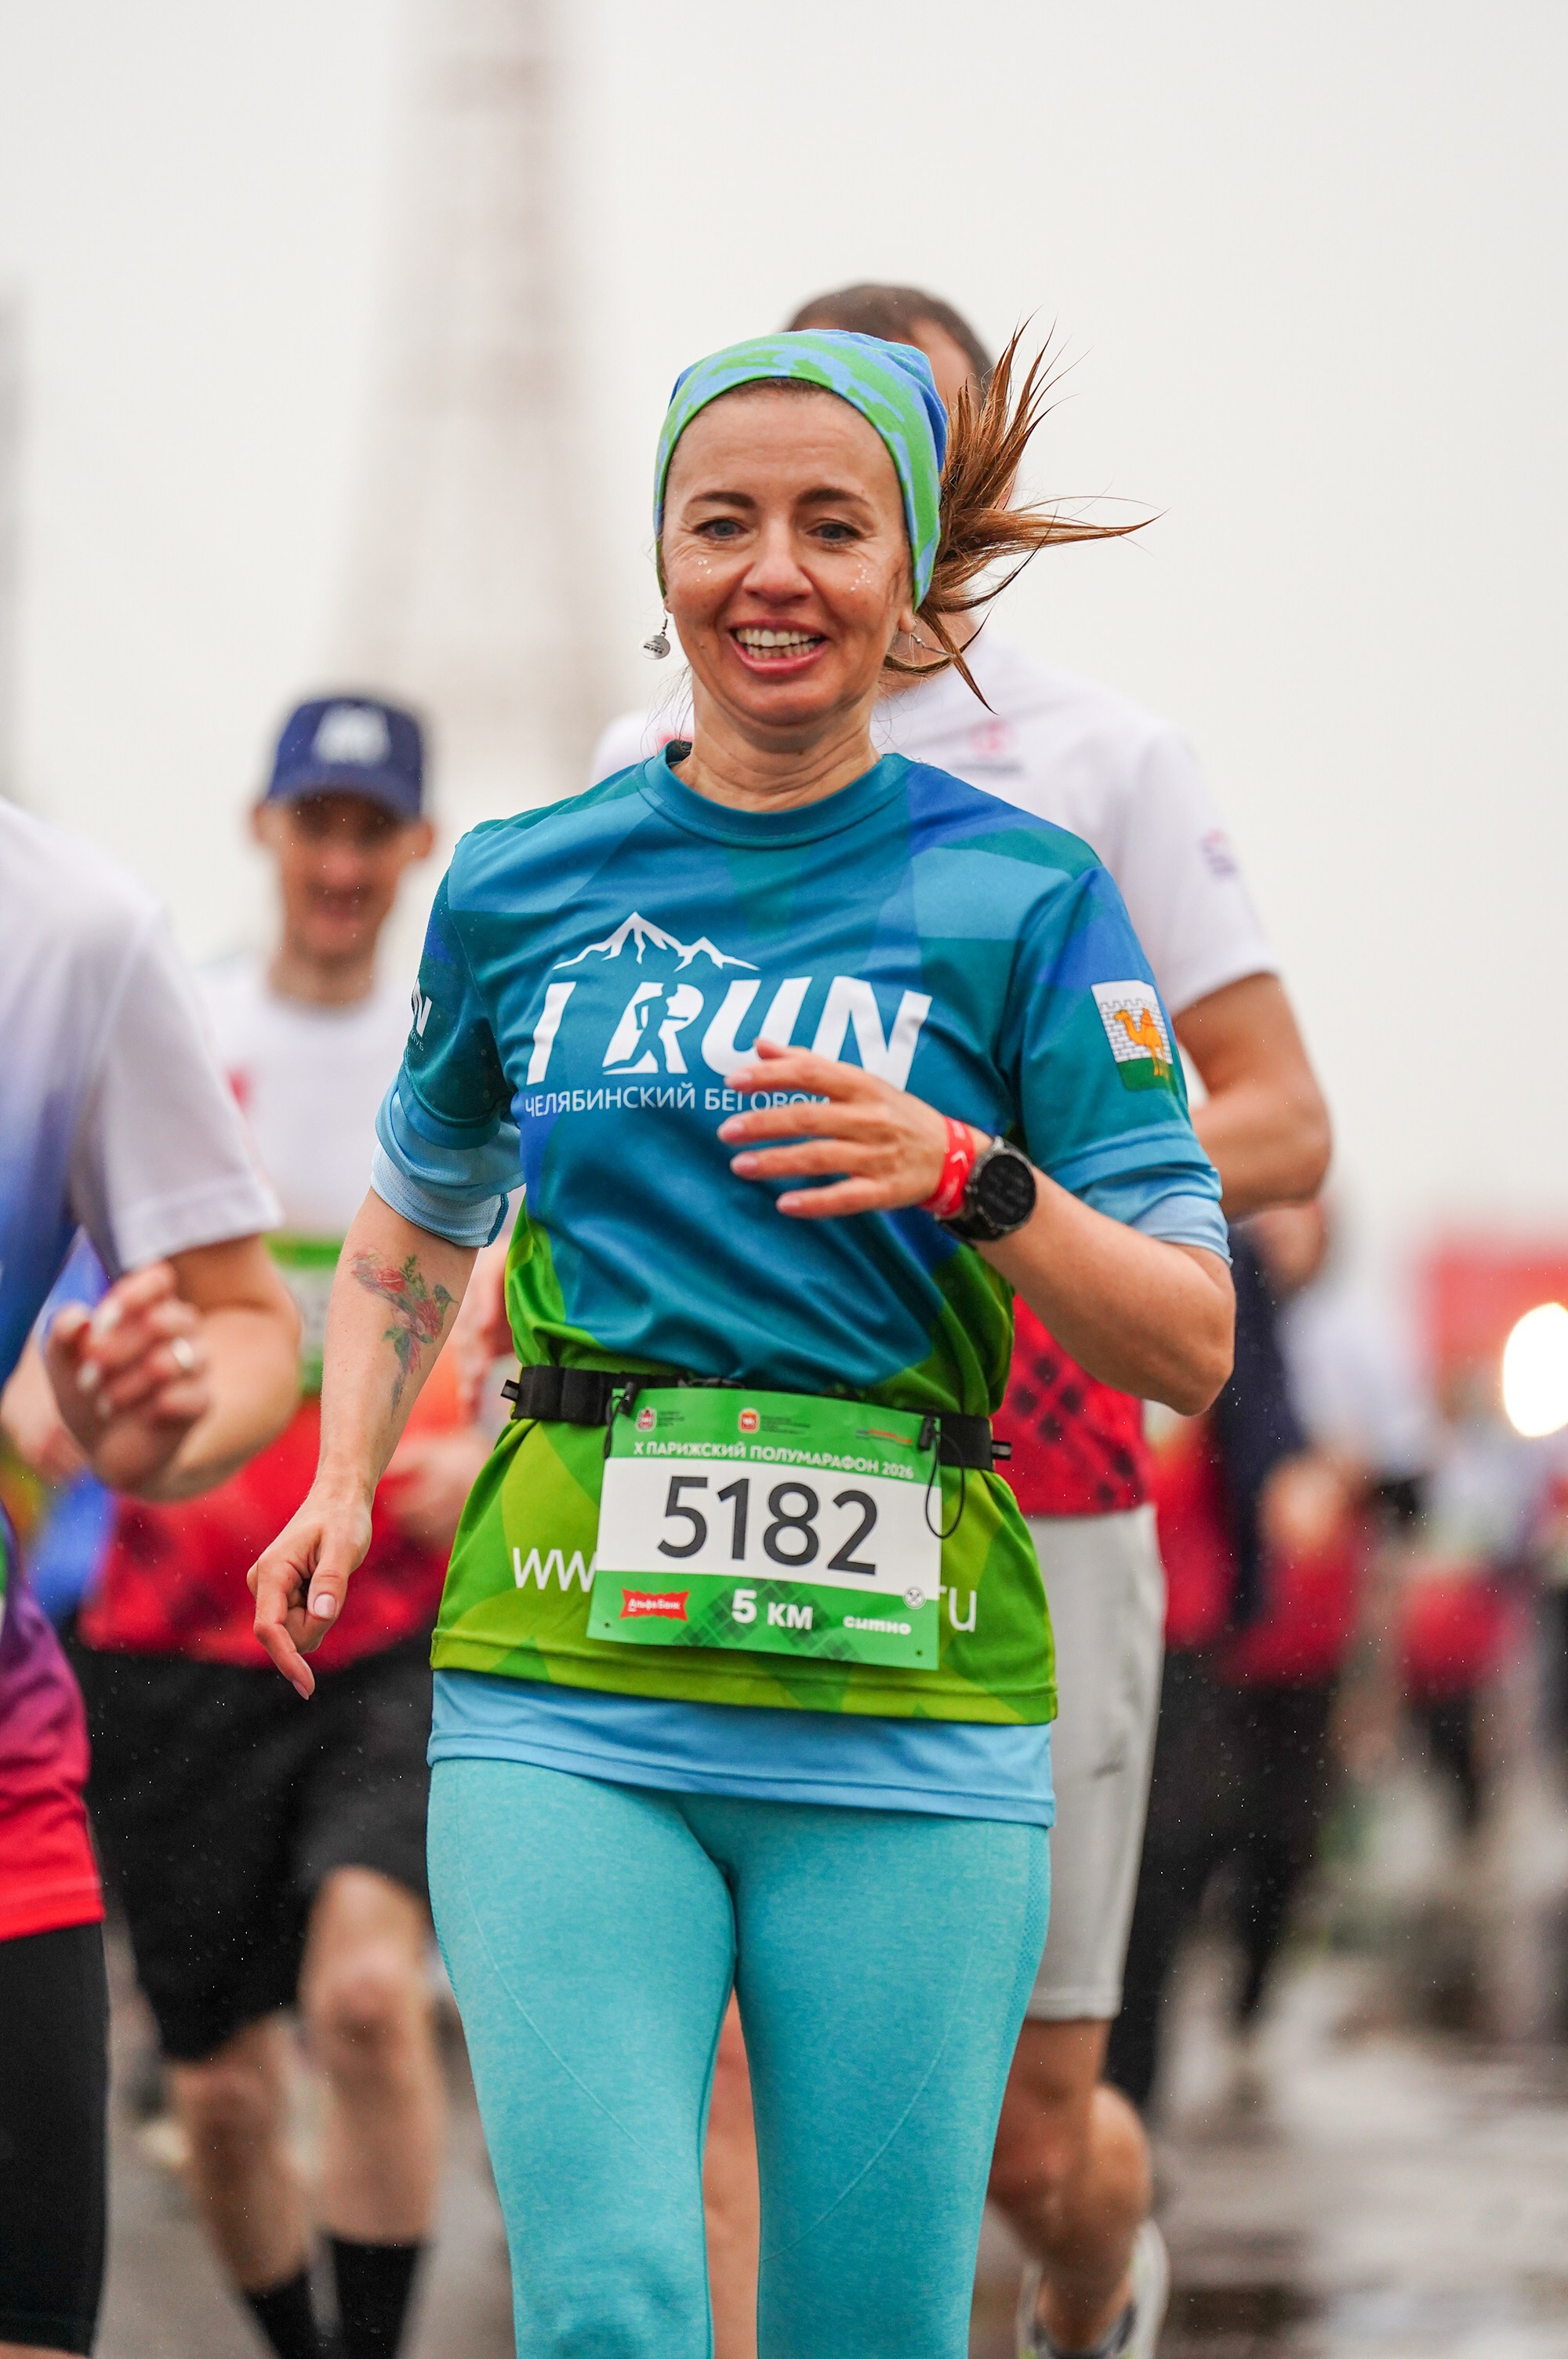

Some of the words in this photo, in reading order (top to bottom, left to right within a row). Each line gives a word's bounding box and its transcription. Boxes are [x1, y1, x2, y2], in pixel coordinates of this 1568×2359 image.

[526, 981, 577, 1086] I
[602, 976, 934, 1091] RUN
[524, 1081, 696, 1118] ЧЕЛЯБИНСКИЙ
[646, 1440, 746, 1459] ПАРИЖСКИЙ
[750, 1445, 880, 1474] ПОЛУМАРАФОН
[881, 1460, 914, 1480] 2026
[657, 1476, 878, 1576] 5182
[731, 1588, 757, 1624] 5
